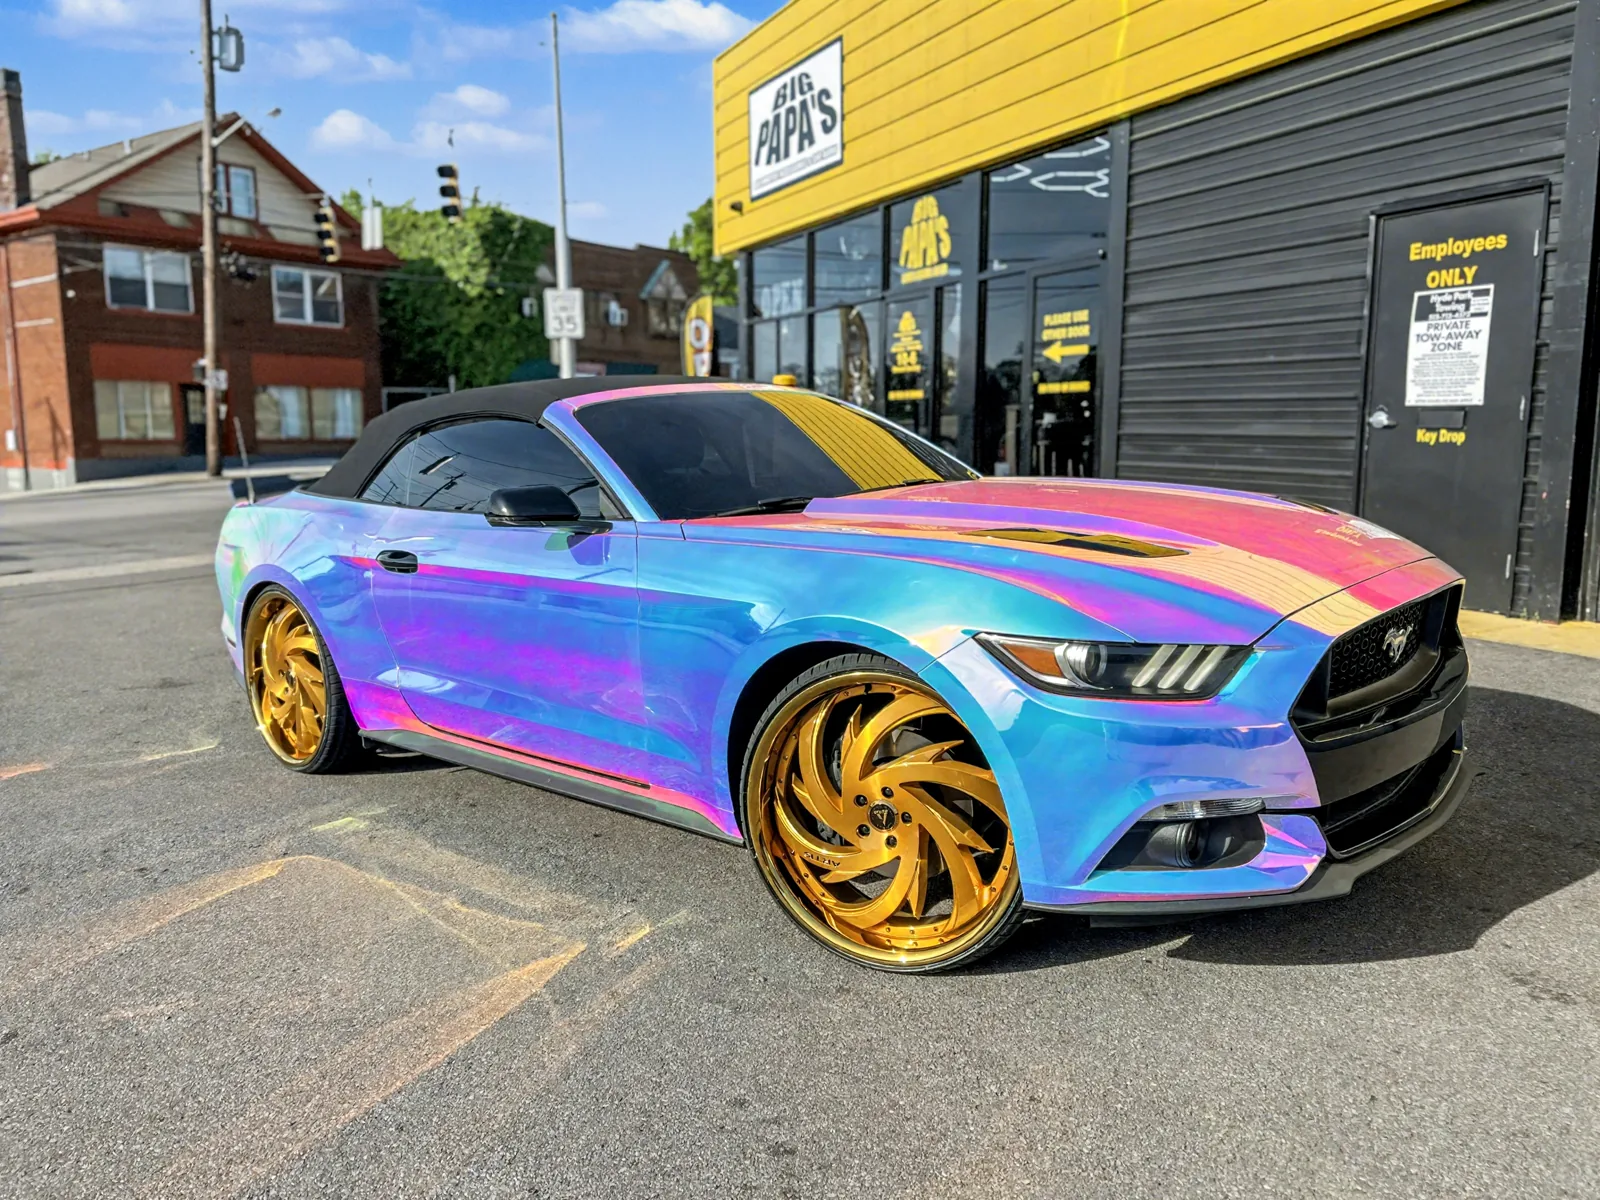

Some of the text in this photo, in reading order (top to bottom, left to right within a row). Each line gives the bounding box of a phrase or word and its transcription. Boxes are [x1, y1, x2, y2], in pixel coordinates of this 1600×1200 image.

[773, 73, 814, 112] BIG
[755, 88, 837, 166] PAPA'S
[911, 195, 939, 224] BIG
[899, 214, 952, 269] PAPA'S
[1409, 234, 1508, 261] Employees
[1426, 265, 1478, 288] ONLY
[1454, 289, 1474, 301] Park
[1435, 302, 1466, 313] Towing
[552, 315, 578, 333] 35
[1427, 320, 1472, 332] PRIVATE
[1415, 329, 1482, 343] TOW-AWAY
[1430, 341, 1463, 352] ZONE
[1416, 428, 1466, 446] Key Drop
